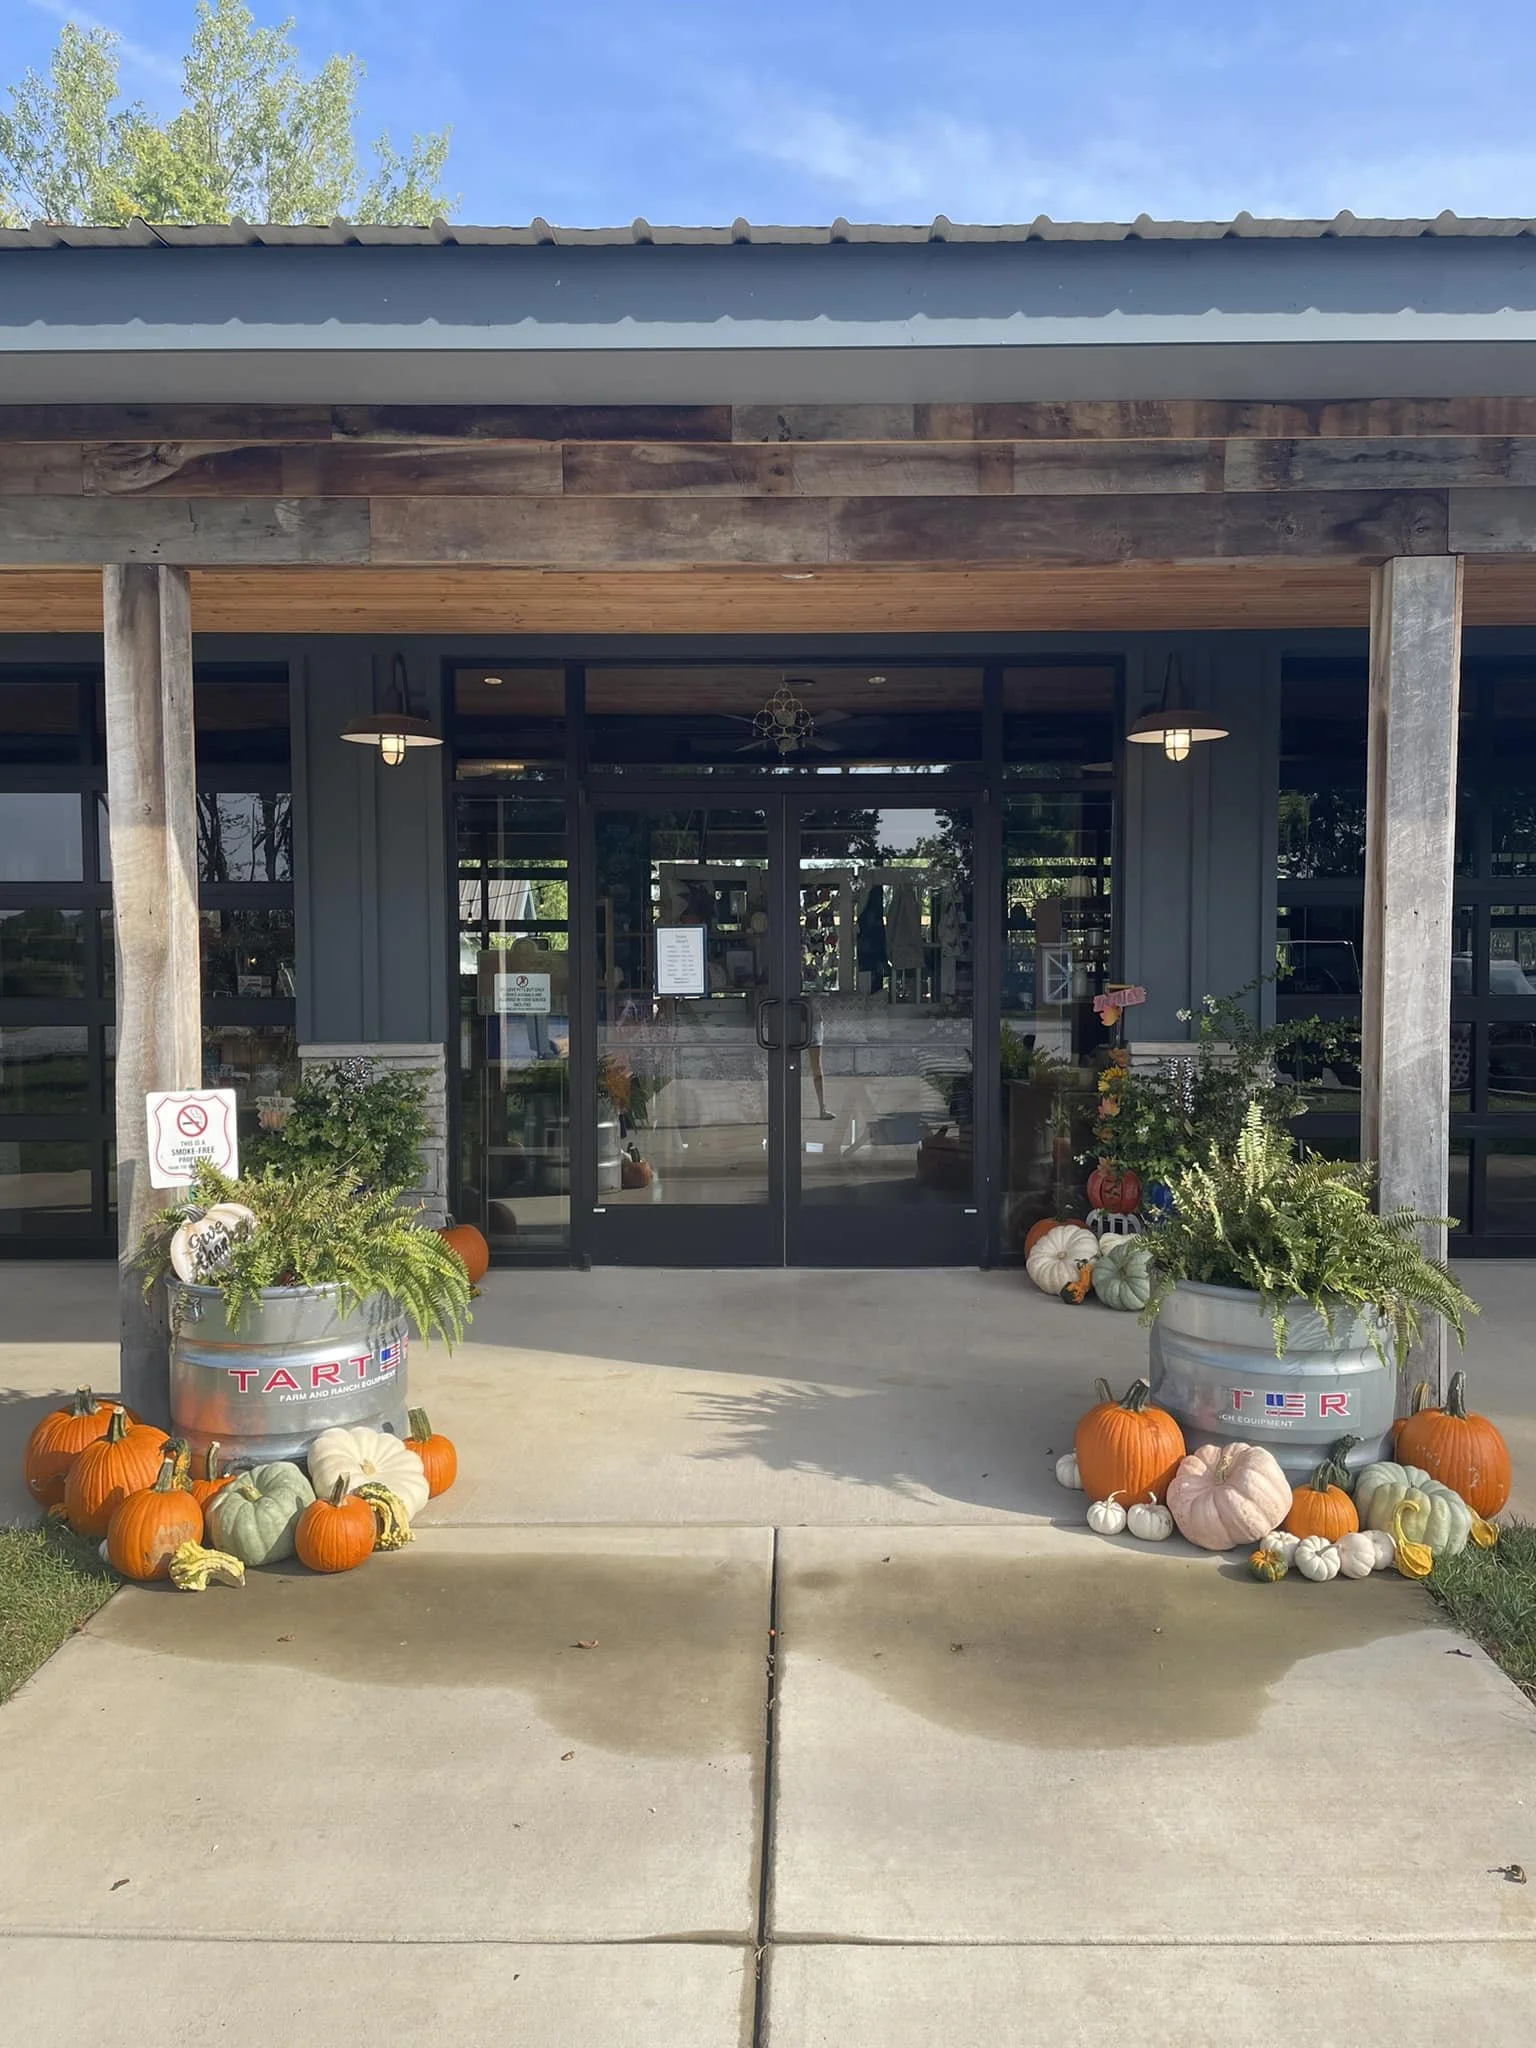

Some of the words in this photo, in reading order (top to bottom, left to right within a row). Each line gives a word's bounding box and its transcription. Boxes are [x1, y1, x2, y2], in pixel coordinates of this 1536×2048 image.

[171, 1145, 215, 1157] SMOKE-FREE
[279, 1393, 307, 1403] FARM
[308, 1389, 329, 1400] AND
[330, 1382, 360, 1396] RANCH
[360, 1368, 397, 1388] EQUIPMENT
[1237, 1415, 1295, 1428] EQUIPMENT
